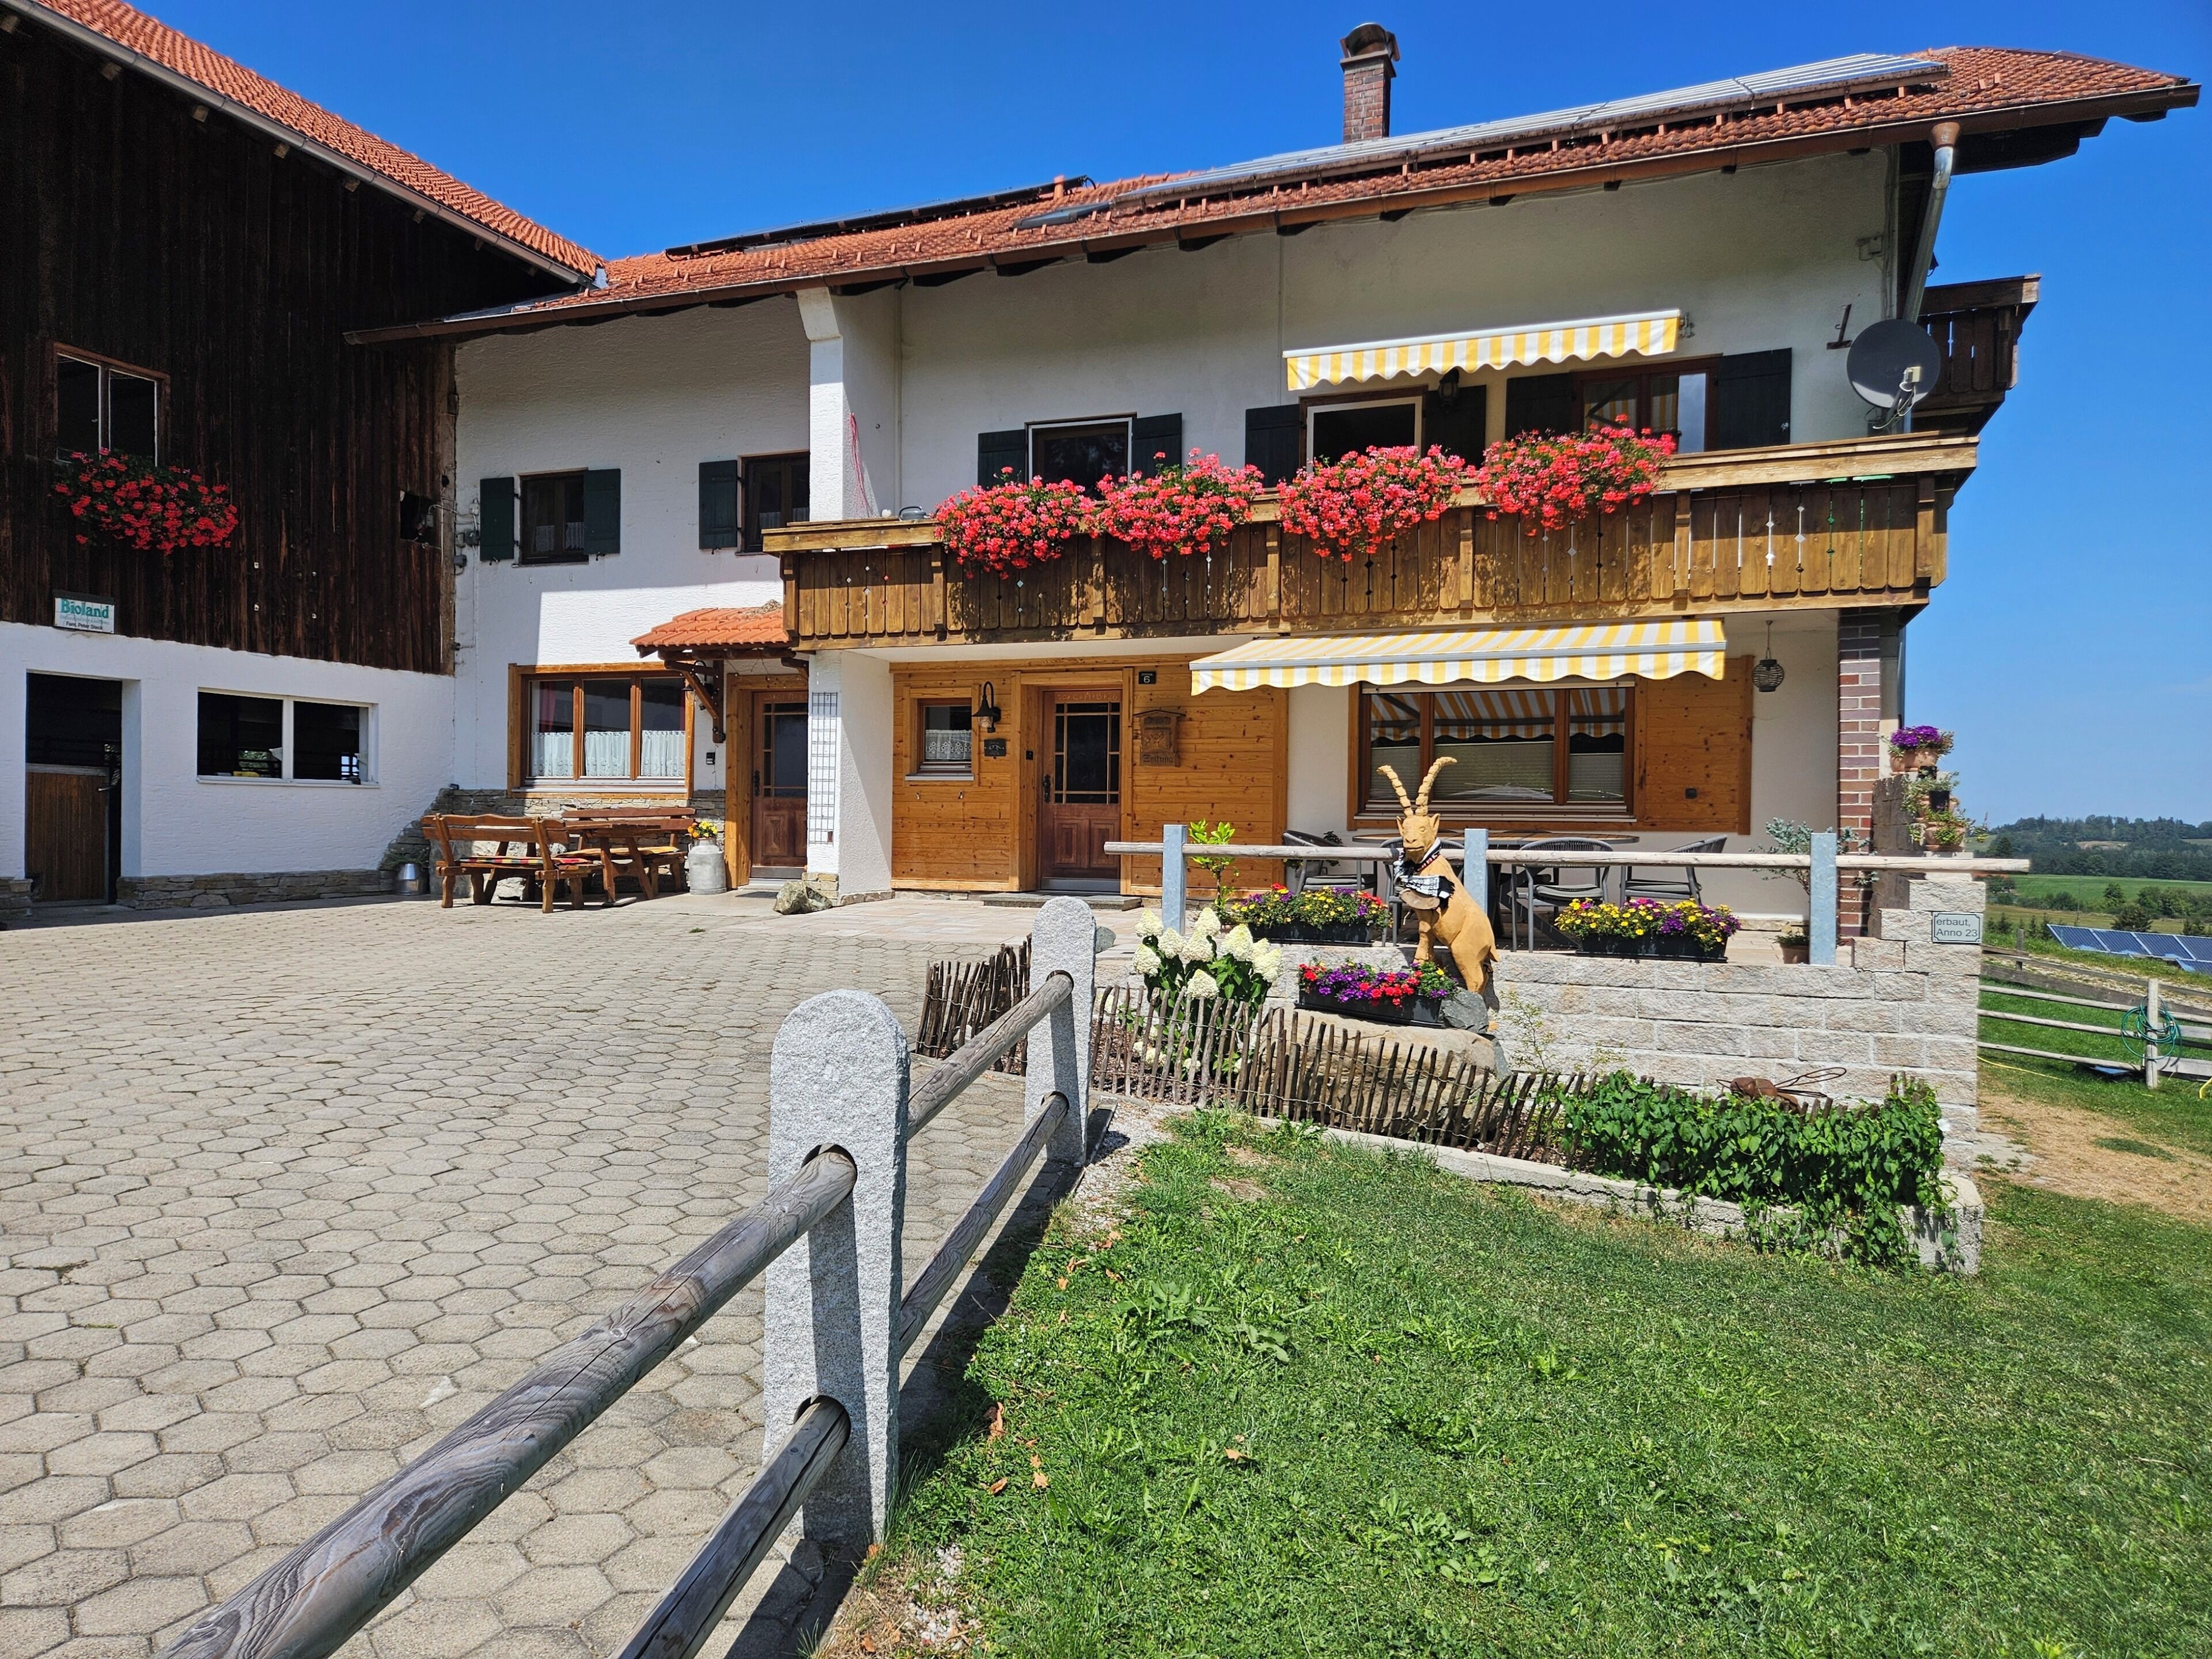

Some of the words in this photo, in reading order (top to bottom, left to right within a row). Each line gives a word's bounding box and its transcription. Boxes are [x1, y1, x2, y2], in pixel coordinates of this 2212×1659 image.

[60, 599, 109, 618] Bioland
[1936, 918, 1971, 926] erbaut,
[1936, 929, 1962, 937] Anno
